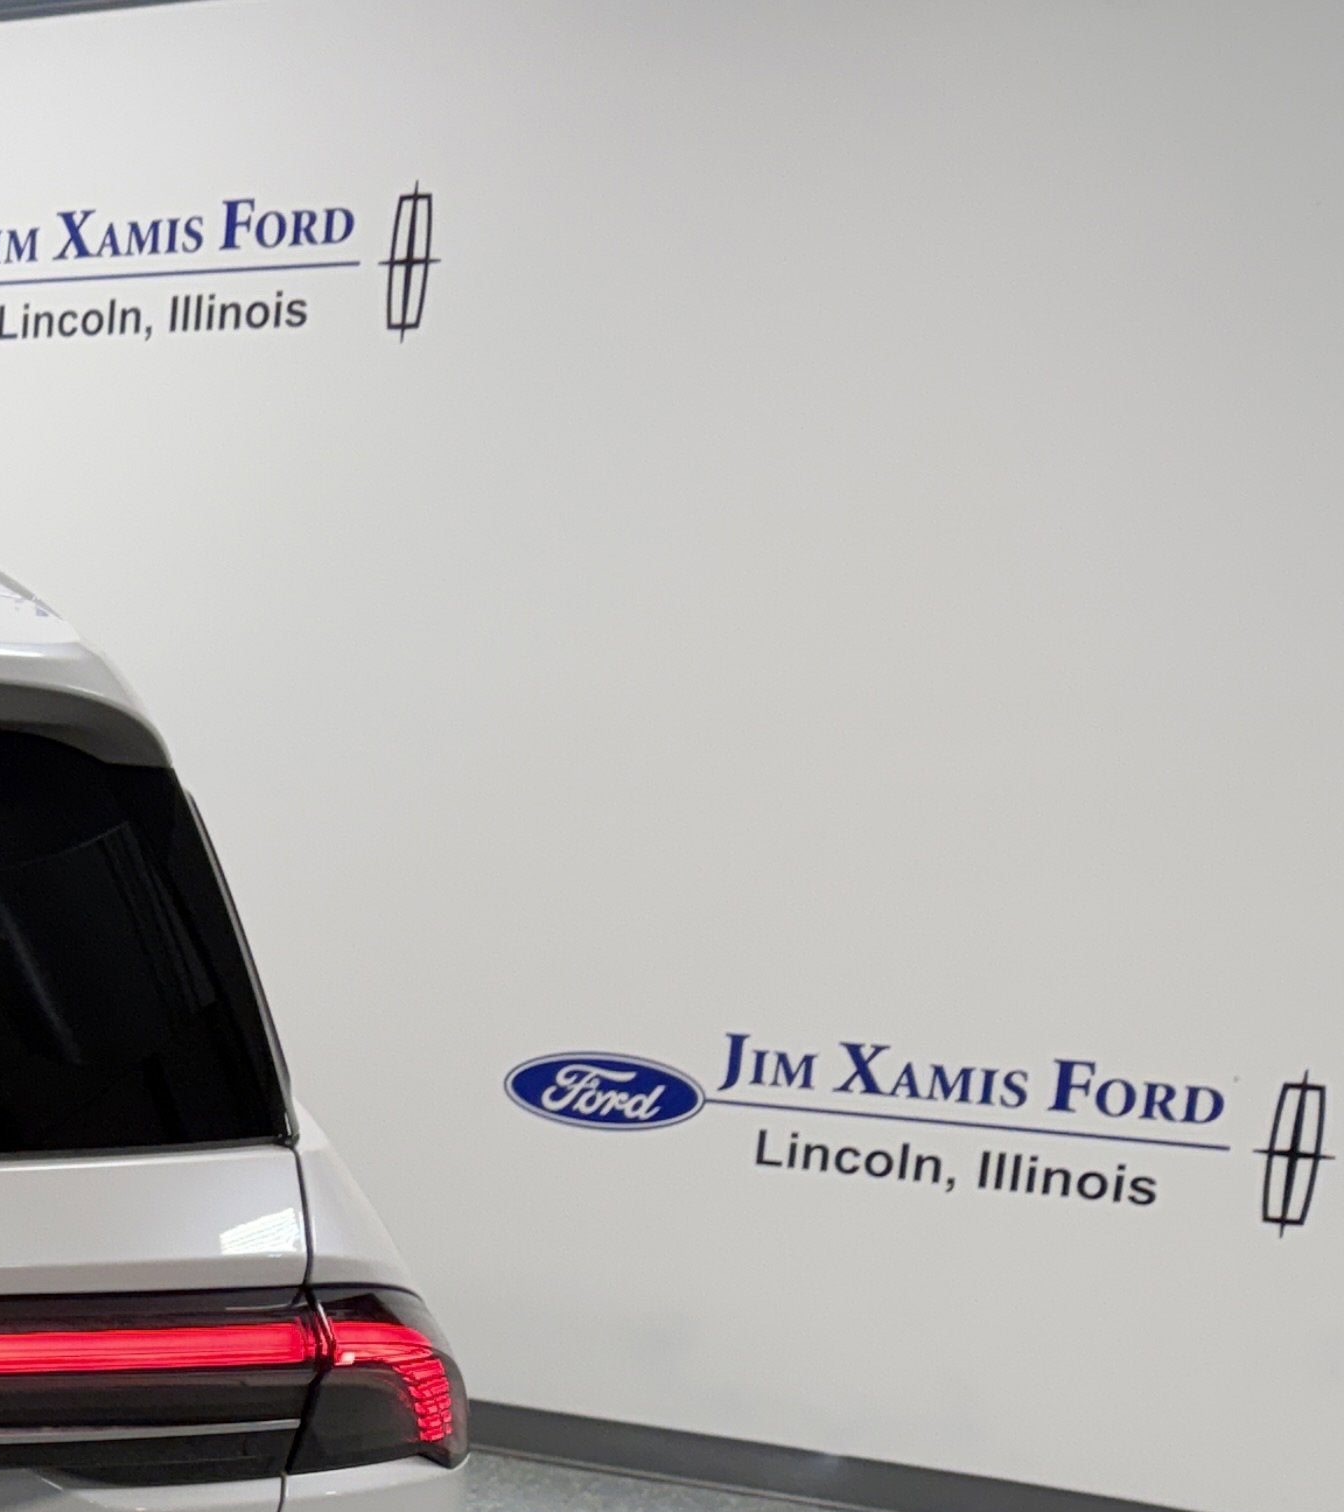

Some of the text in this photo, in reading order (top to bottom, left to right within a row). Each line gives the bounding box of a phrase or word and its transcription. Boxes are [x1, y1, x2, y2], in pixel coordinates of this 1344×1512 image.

[53, 210, 203, 260] XAMIS
[219, 198, 356, 250] FORD
[169, 290, 308, 333] Illinois
[540, 1065, 661, 1121] Ford
[717, 1033, 1225, 1125] JIM XAMIS FORD
[756, 1129, 1157, 1206] Lincoln, Illinois
